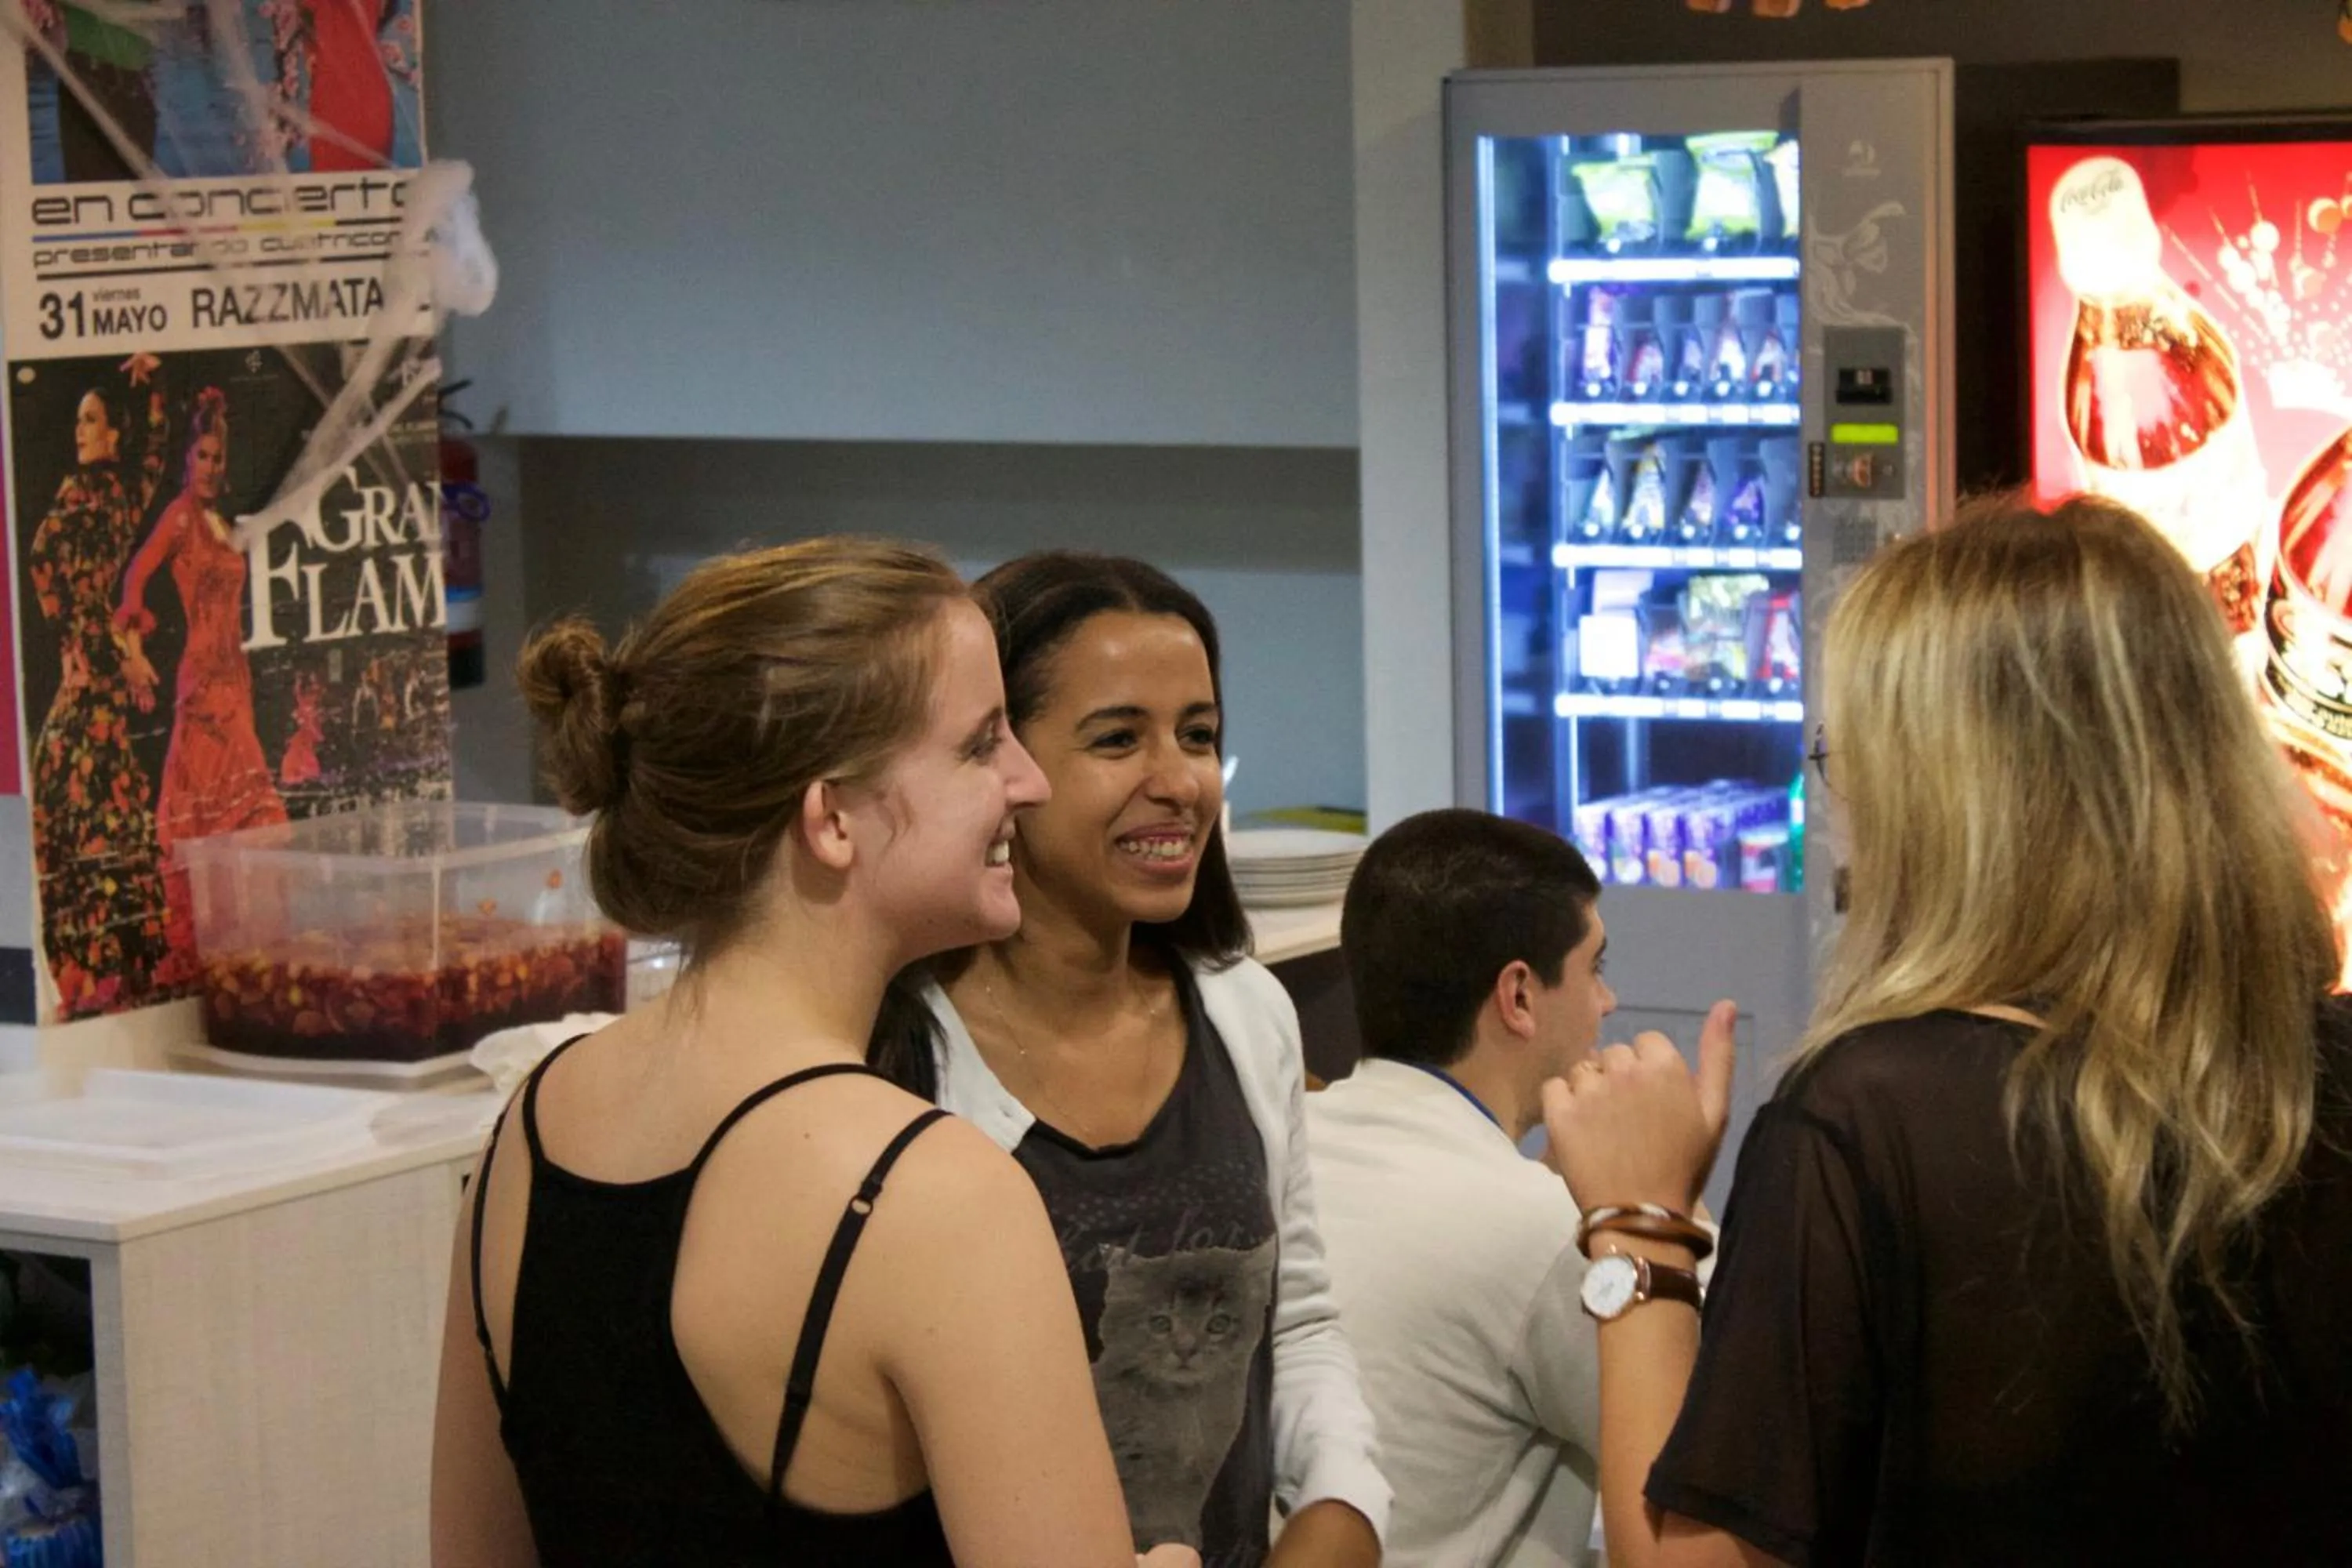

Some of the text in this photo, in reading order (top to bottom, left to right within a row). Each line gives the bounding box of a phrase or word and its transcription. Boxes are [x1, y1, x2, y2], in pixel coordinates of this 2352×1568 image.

[32, 195, 114, 226] en
[39, 277, 431, 340] 31 MAYO RAZZMATA
[237, 514, 448, 651] FLAM
